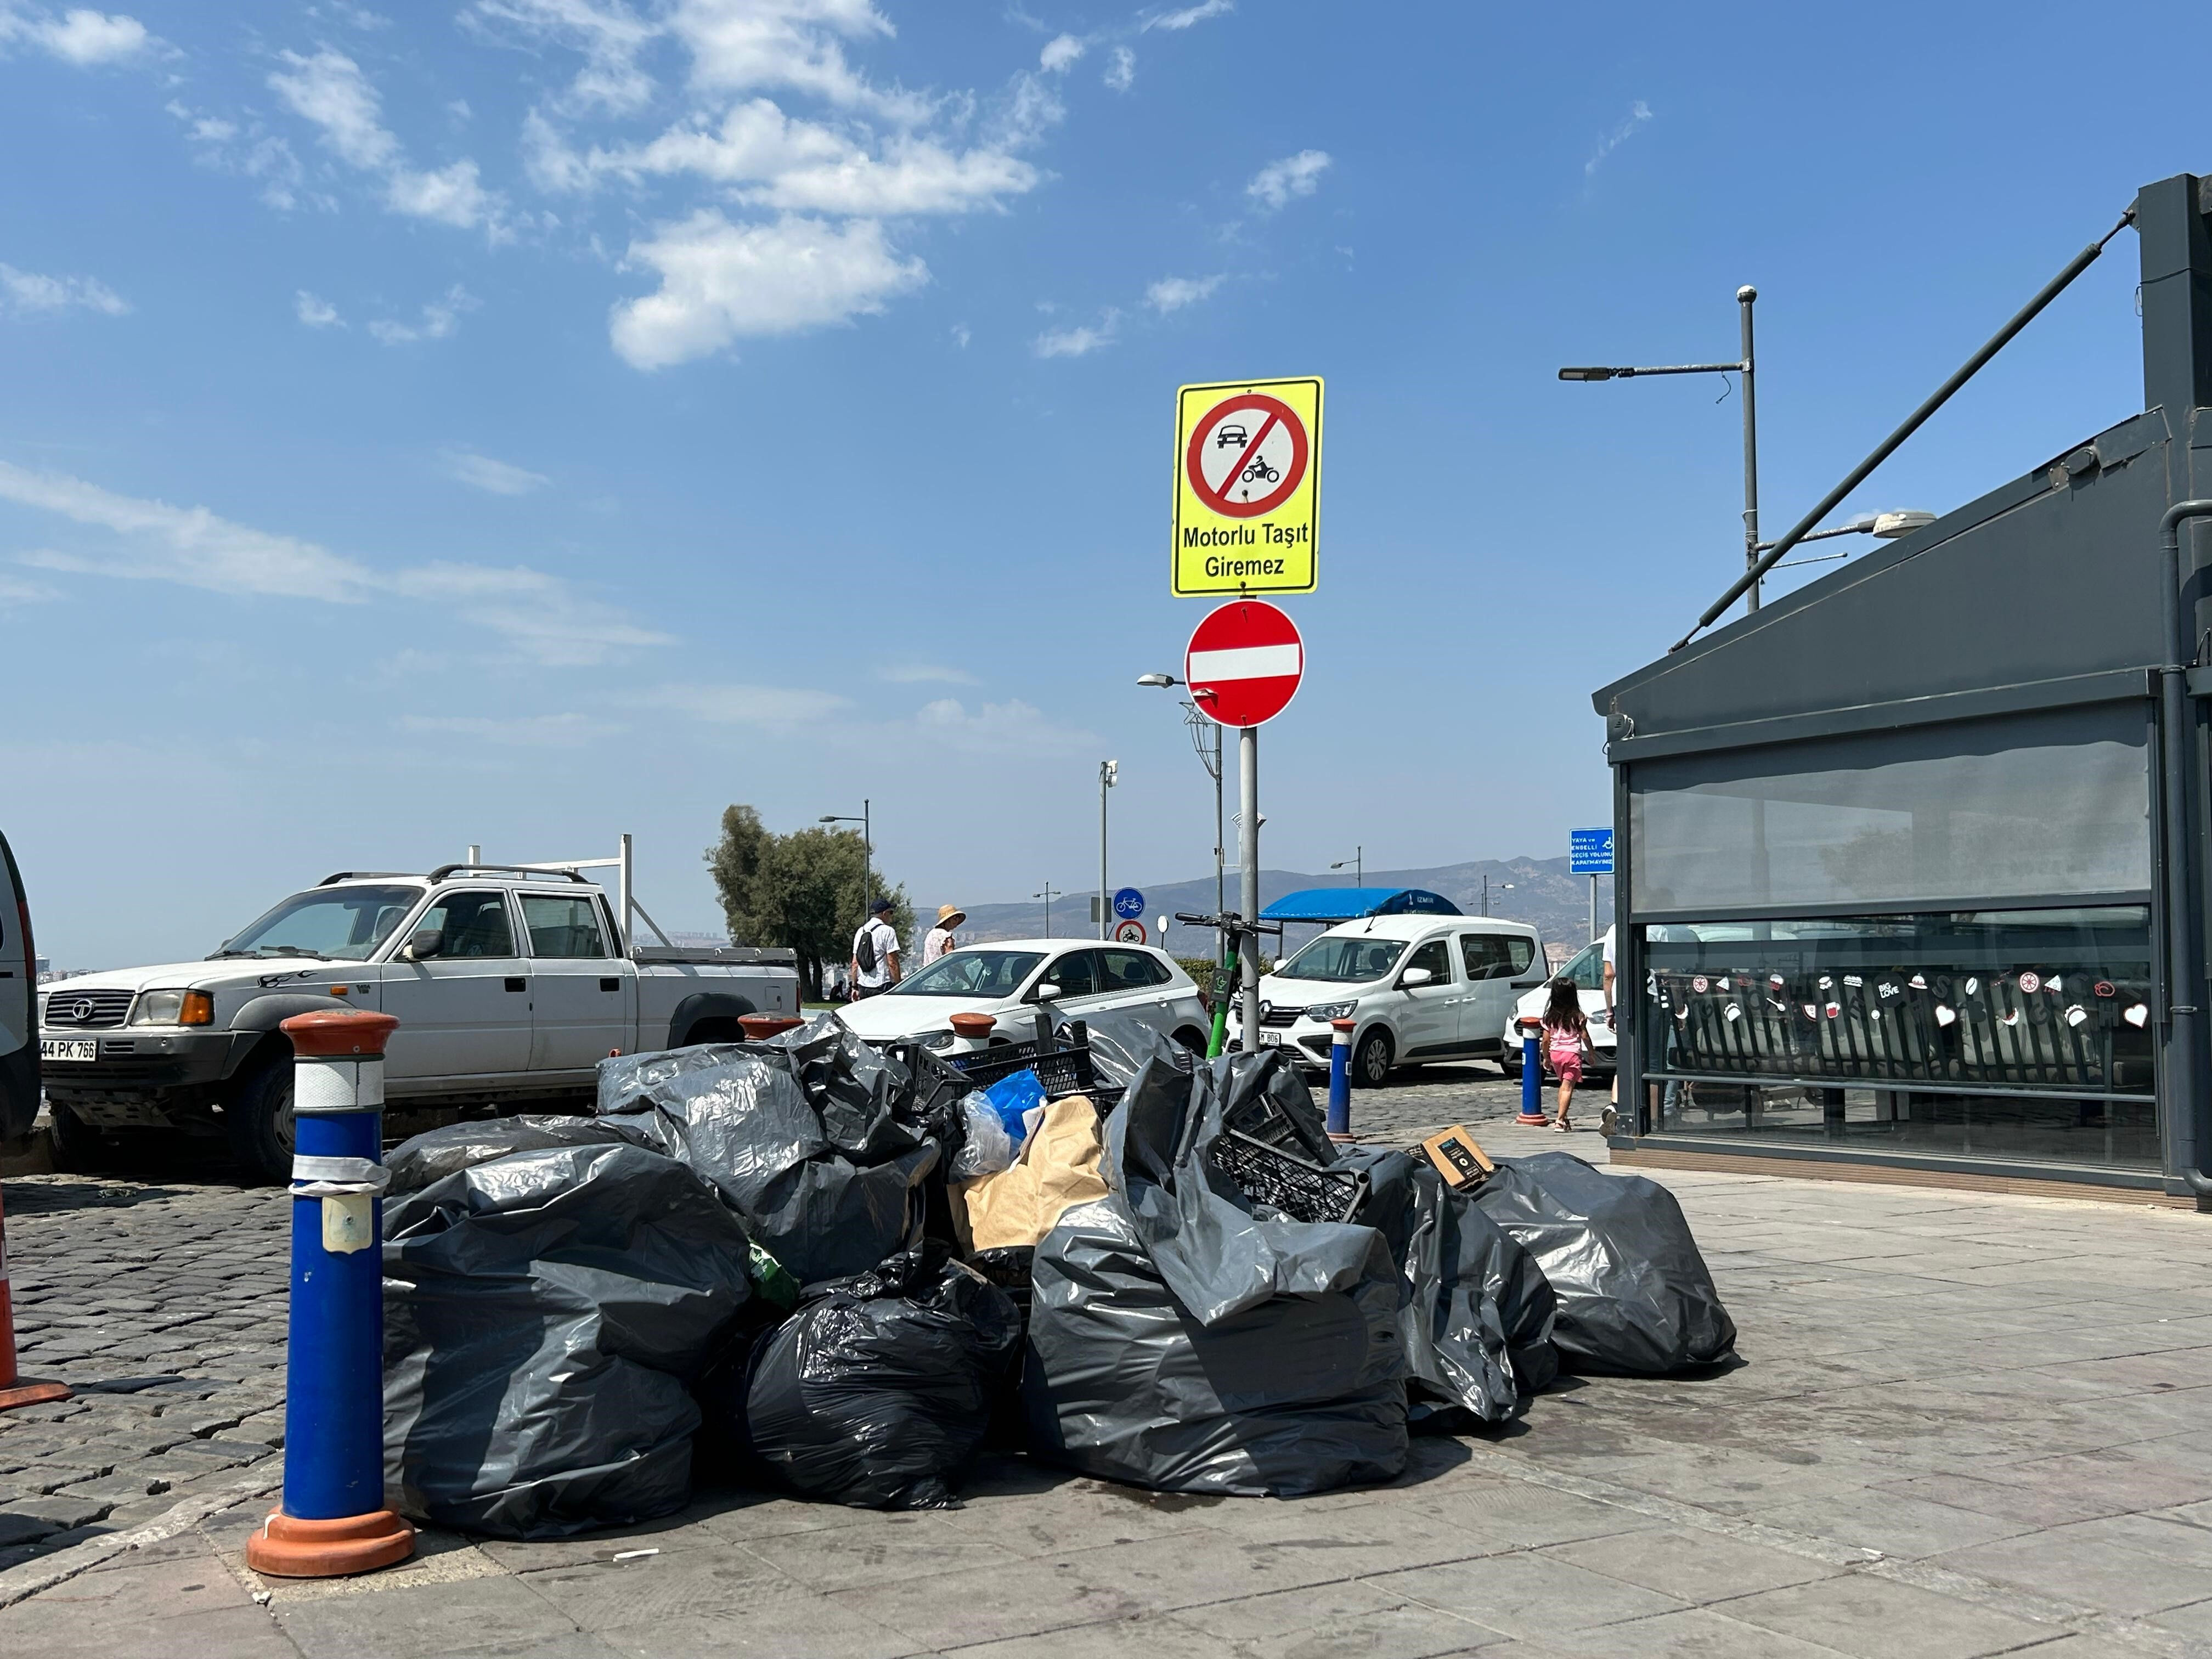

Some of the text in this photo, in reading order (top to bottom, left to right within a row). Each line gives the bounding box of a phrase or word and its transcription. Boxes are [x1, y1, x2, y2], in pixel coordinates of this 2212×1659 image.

[1183, 522, 1308, 549] Motorlu Taşıt
[1205, 556, 1284, 577] Giremez
[1878, 982, 1892, 992] BIG
[1880, 986, 1900, 998] LOVE
[41, 1042, 94, 1058] 44 PK 766
